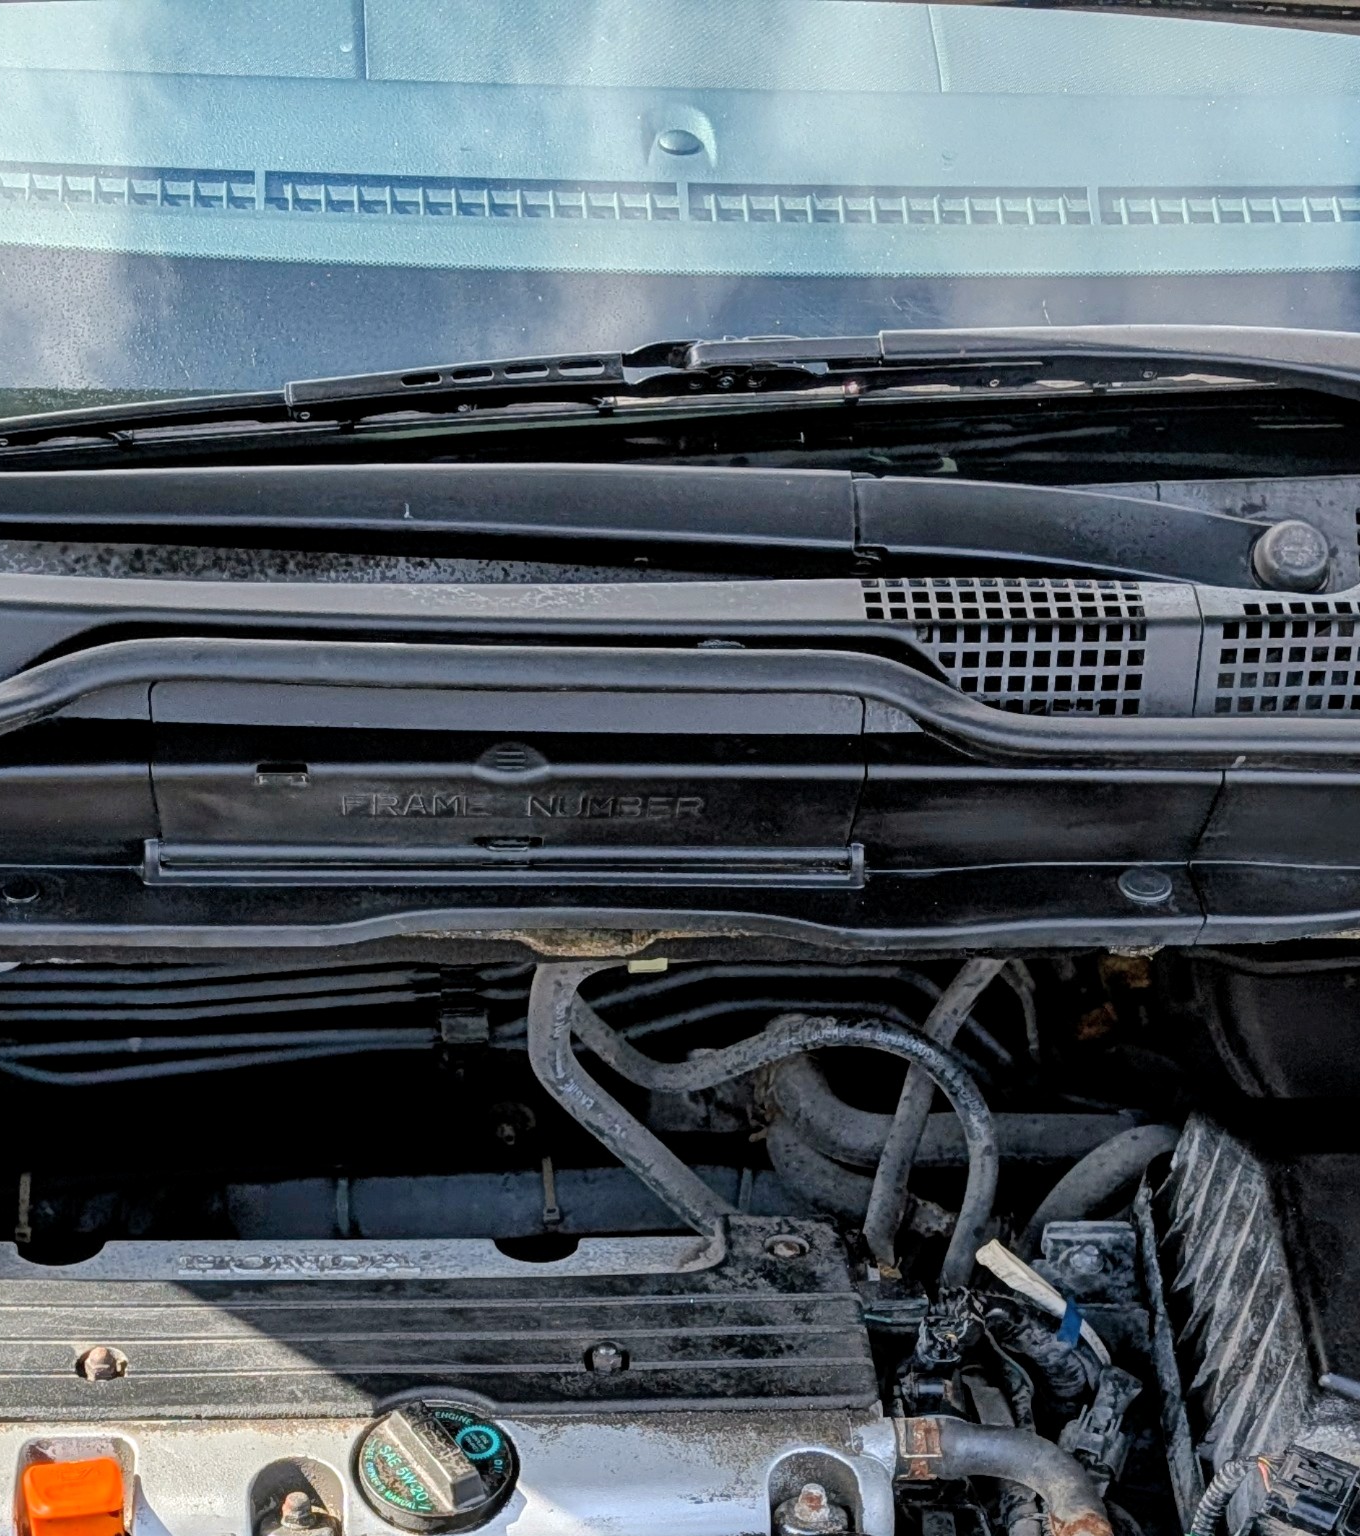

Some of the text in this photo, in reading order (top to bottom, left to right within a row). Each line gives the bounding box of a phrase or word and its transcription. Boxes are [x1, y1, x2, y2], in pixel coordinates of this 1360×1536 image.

[341, 794, 706, 819] FRAME NUMBER
[178, 1253, 421, 1275] HONDA
[434, 1411, 474, 1425] ENGINE
[379, 1444, 429, 1502] SAE 5W-20
[384, 1490, 418, 1511] MANUAL
